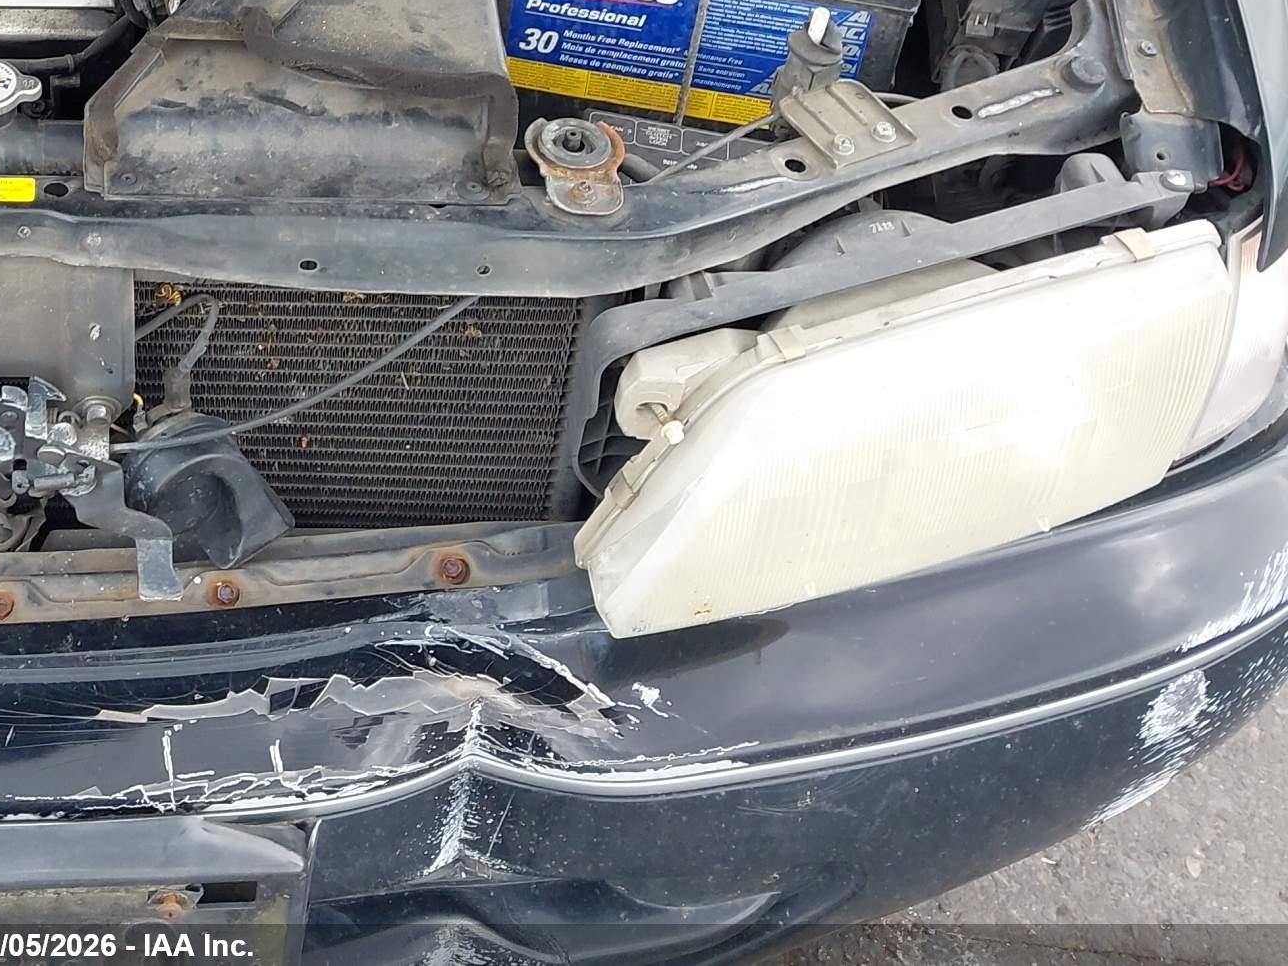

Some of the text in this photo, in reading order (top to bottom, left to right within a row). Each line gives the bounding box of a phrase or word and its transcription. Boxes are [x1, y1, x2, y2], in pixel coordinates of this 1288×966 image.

[518, 27, 559, 54] 30
[563, 29, 596, 42] Months
[597, 35, 617, 45] Free
[561, 42, 583, 52] Mois
[584, 44, 596, 54] de
[597, 48, 659, 64] remplacement
[727, 57, 743, 66] Free
[559, 54, 588, 66] Meses
[589, 57, 600, 67] de
[602, 61, 647, 74] reemplazo
[698, 65, 715, 74] Sans
